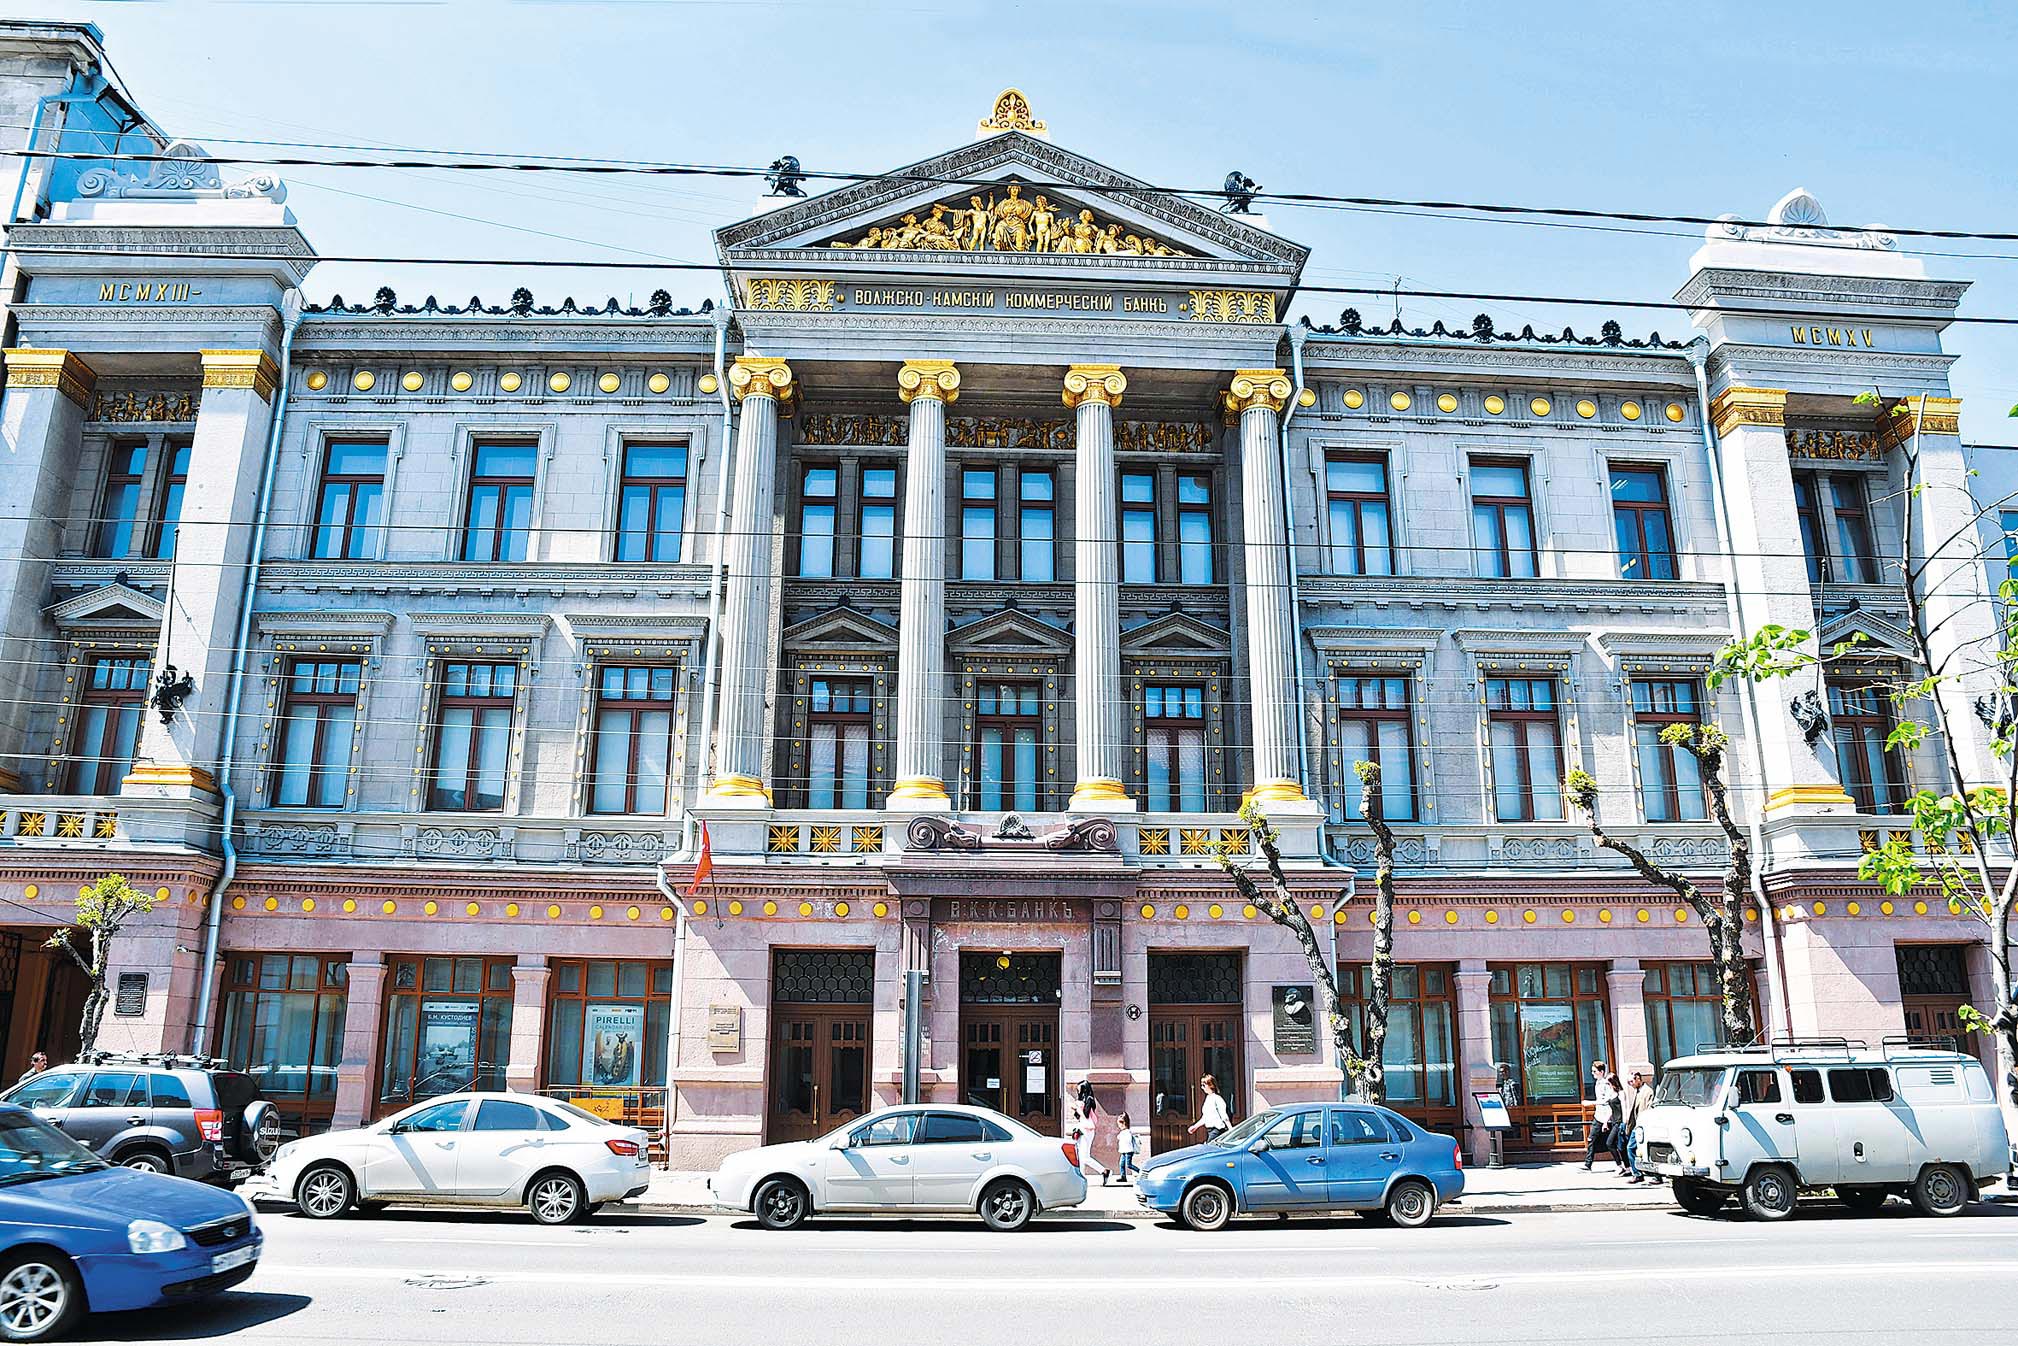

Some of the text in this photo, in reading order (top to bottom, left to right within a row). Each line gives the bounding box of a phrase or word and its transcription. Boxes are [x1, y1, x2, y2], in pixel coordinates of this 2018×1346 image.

[1123, 296, 1168, 313] БАНКЪ
[1791, 326, 1874, 348] MCMXV
[596, 1016, 635, 1024] PIRELLI
